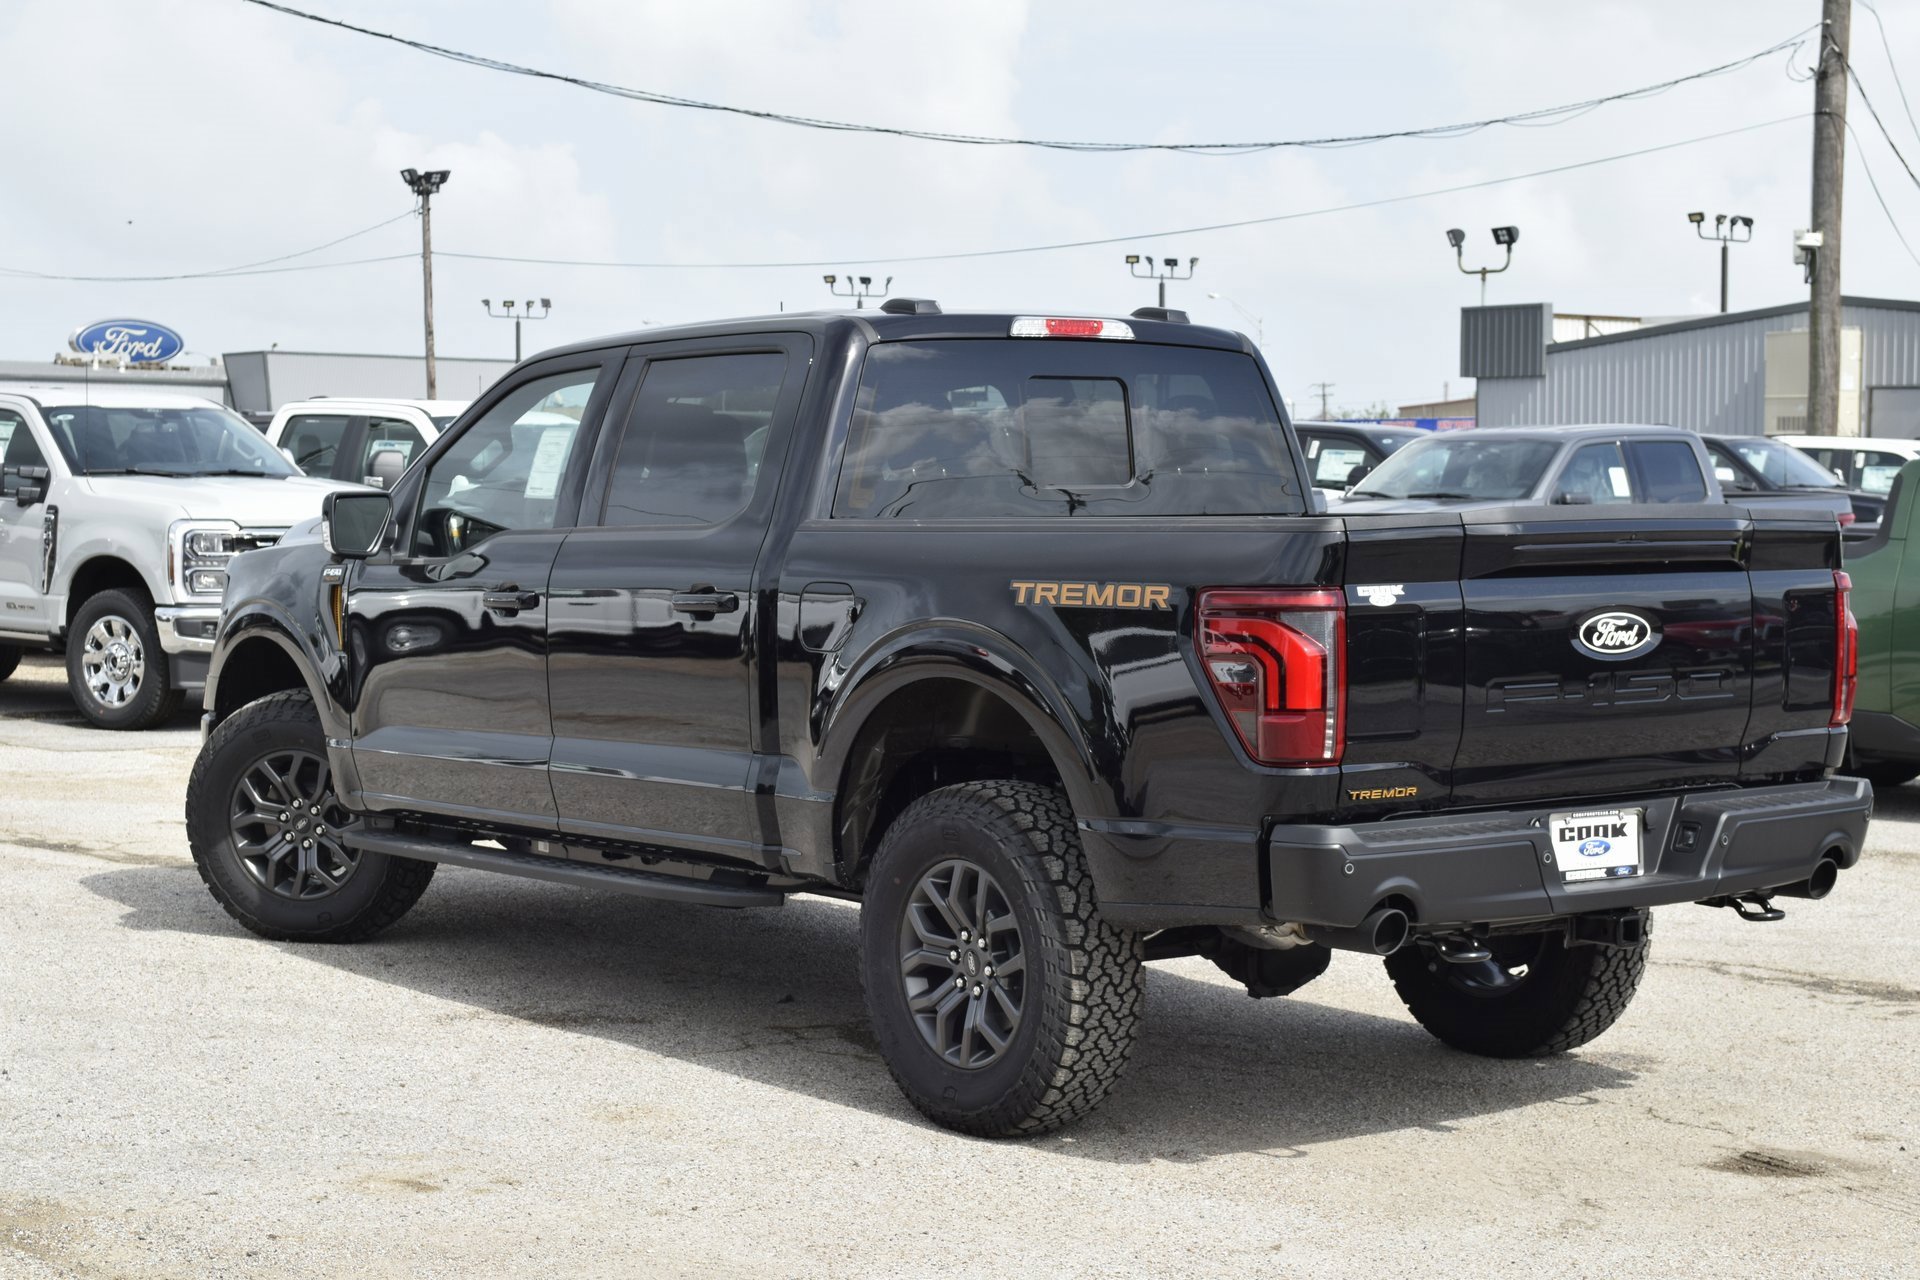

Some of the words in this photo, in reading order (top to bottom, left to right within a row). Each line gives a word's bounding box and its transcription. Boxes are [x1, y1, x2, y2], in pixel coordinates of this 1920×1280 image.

[98, 326, 163, 360] Ford
[1011, 581, 1171, 609] TREMOR
[1592, 618, 1639, 647] Ford
[1486, 666, 1735, 712] F-150
[1349, 787, 1417, 800] TREMOR
[1559, 823, 1628, 842] COOK
[1583, 841, 1605, 856] Ford
